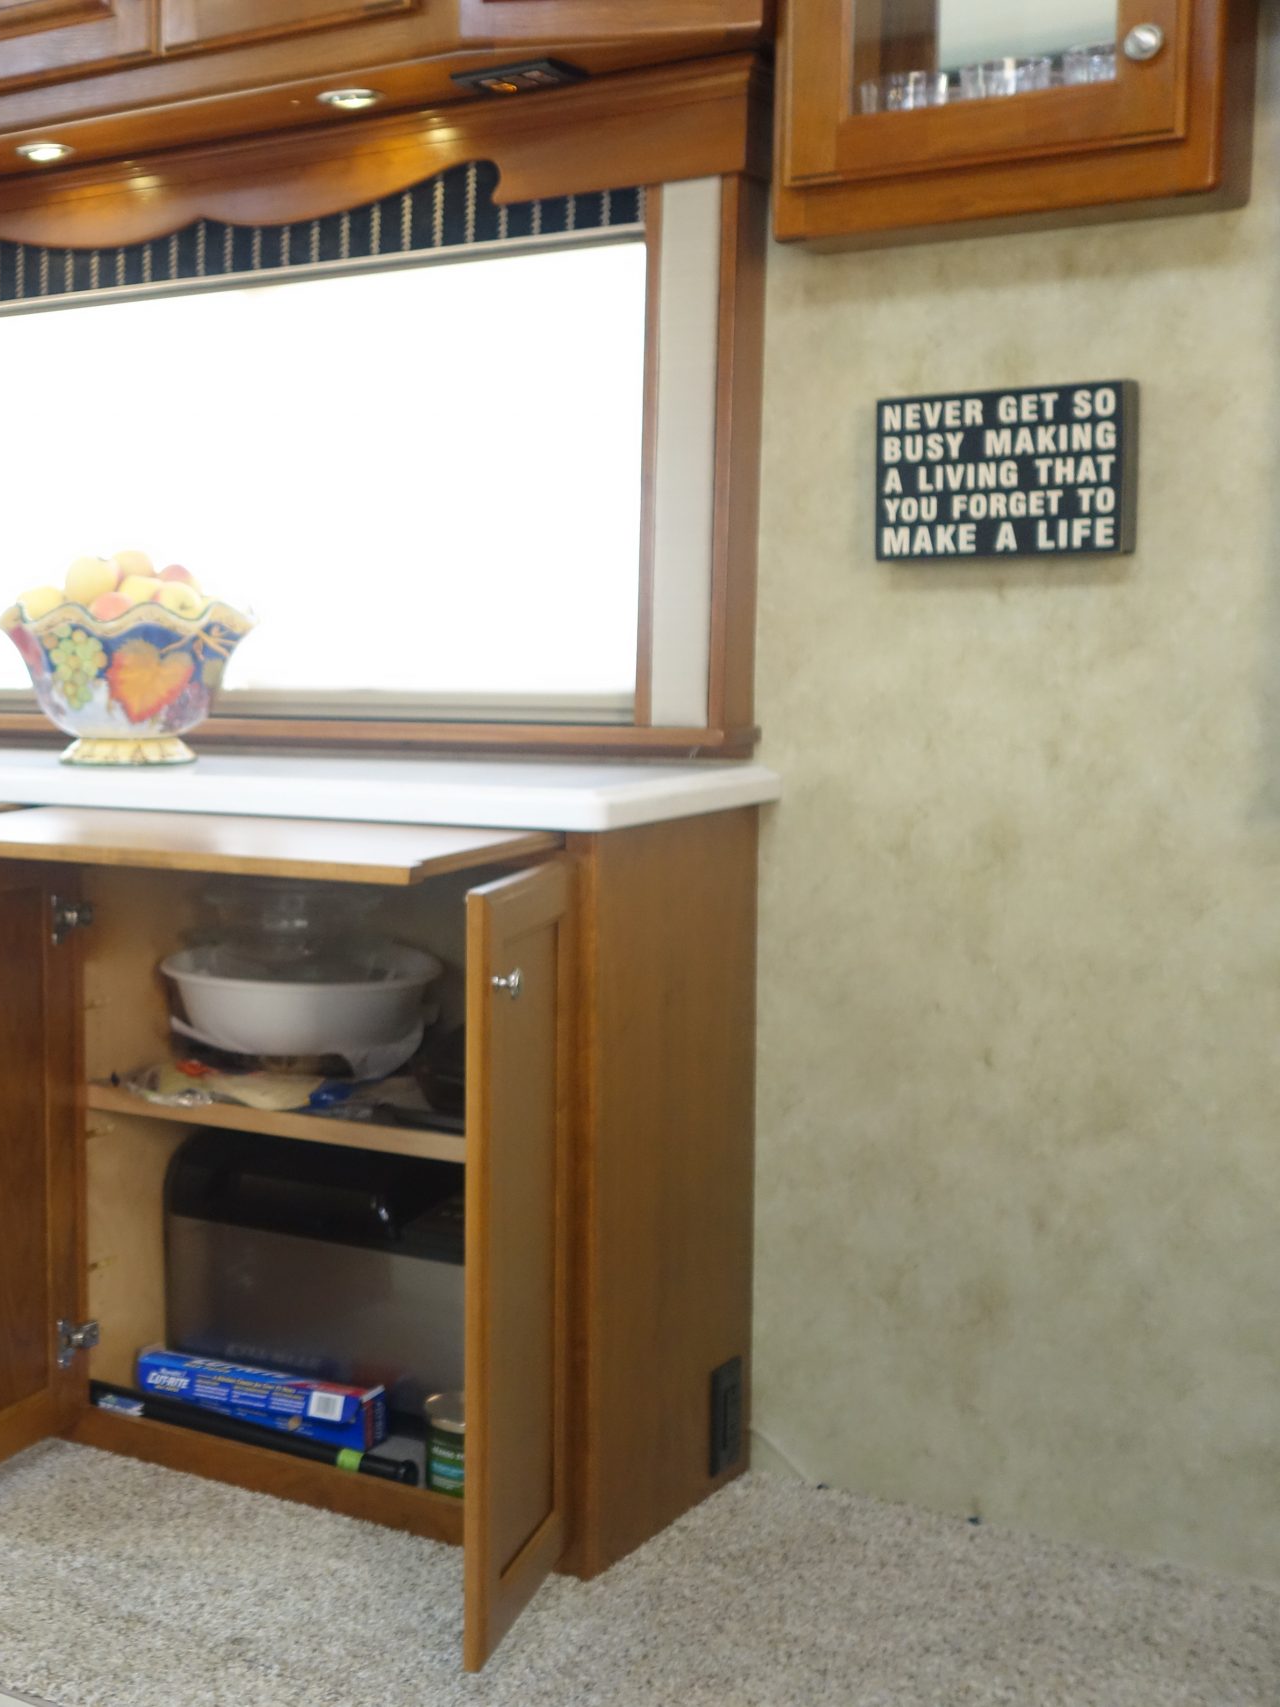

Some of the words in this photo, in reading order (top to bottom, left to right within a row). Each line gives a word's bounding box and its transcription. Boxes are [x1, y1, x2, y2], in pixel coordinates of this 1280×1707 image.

[883, 398, 984, 432] NEVER
[997, 392, 1059, 424] GET
[1072, 387, 1117, 419] SO
[883, 431, 964, 464] BUSY
[984, 420, 1117, 457] MAKING
[883, 467, 903, 495] A
[917, 460, 1019, 493] LIVING
[1034, 454, 1117, 486] THAT
[884, 496, 938, 523] YOU
[951, 489, 1064, 521] FORGET
[1077, 486, 1116, 514] TO
[883, 523, 977, 556] MAKE
[995, 521, 1018, 552] A
[1037, 516, 1115, 551] LIFE
